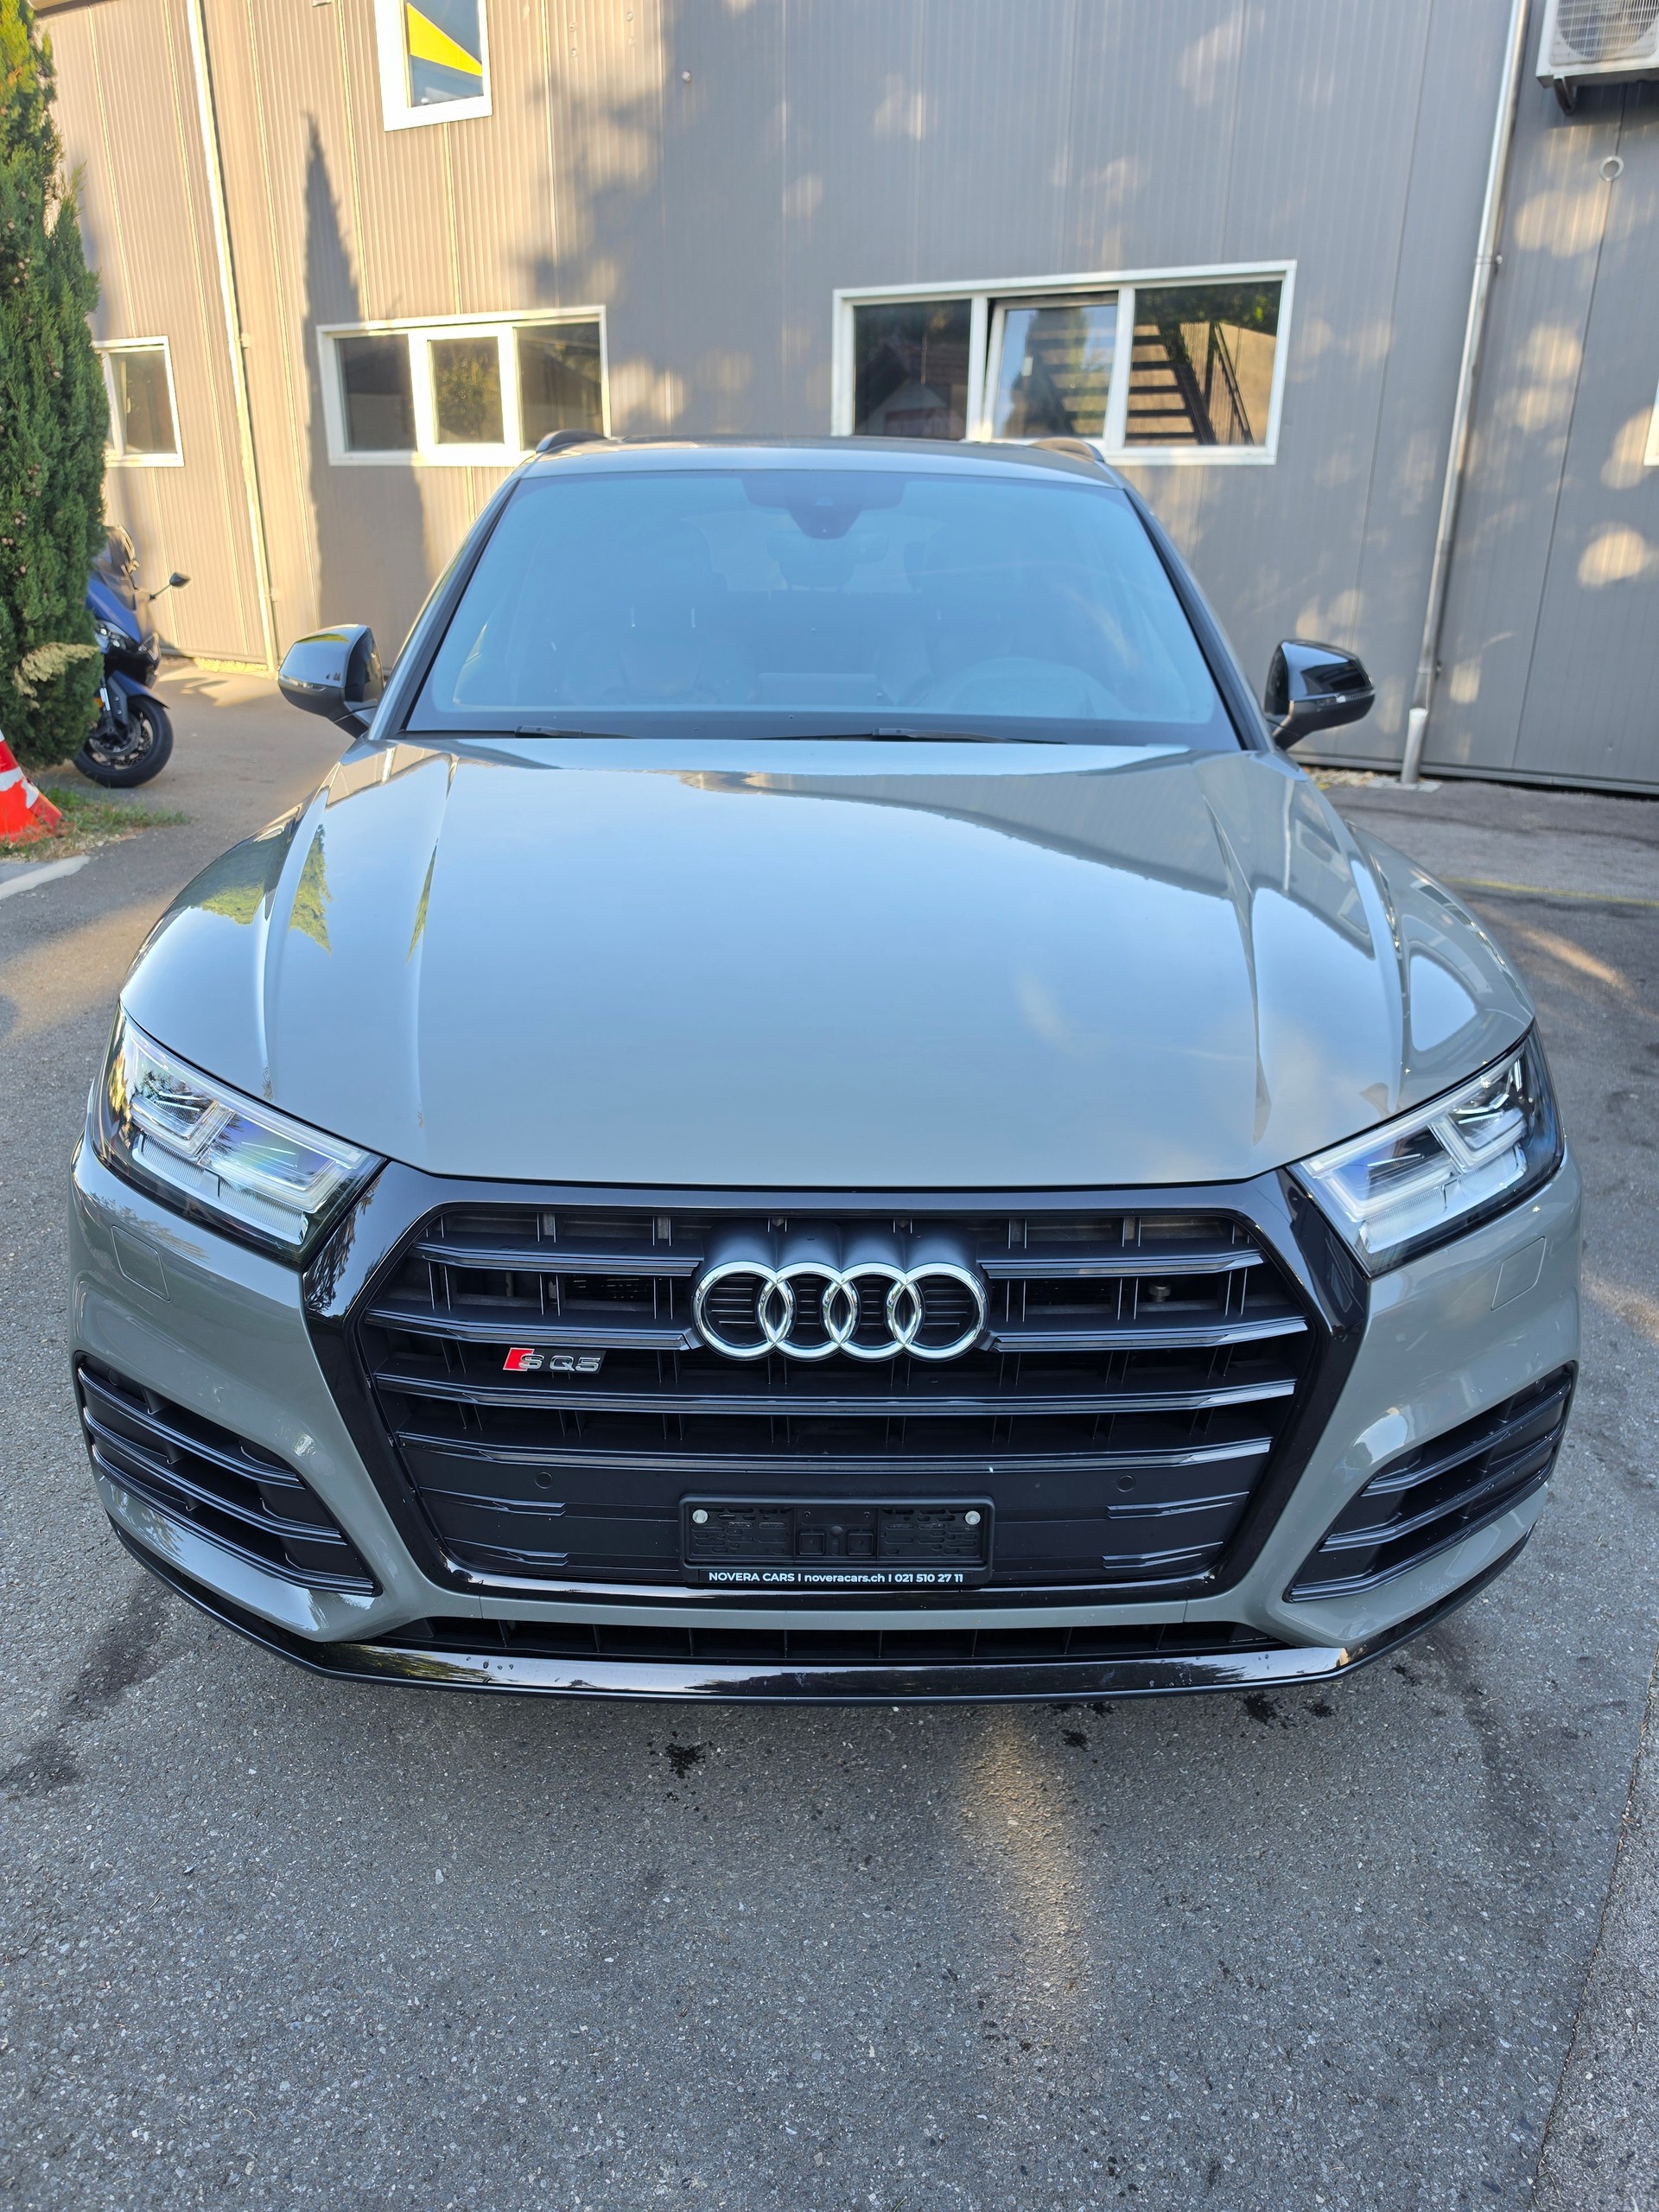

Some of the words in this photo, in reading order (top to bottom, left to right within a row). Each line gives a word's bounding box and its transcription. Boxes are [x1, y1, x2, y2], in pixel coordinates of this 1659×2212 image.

[709, 1572, 760, 1582] NOVERA
[762, 1573, 796, 1582] CARS
[804, 1573, 886, 1583] noveracars.ch
[894, 1573, 914, 1583] 021
[915, 1573, 936, 1583] 510
[937, 1573, 952, 1583] 27
[953, 1573, 963, 1583] 11
